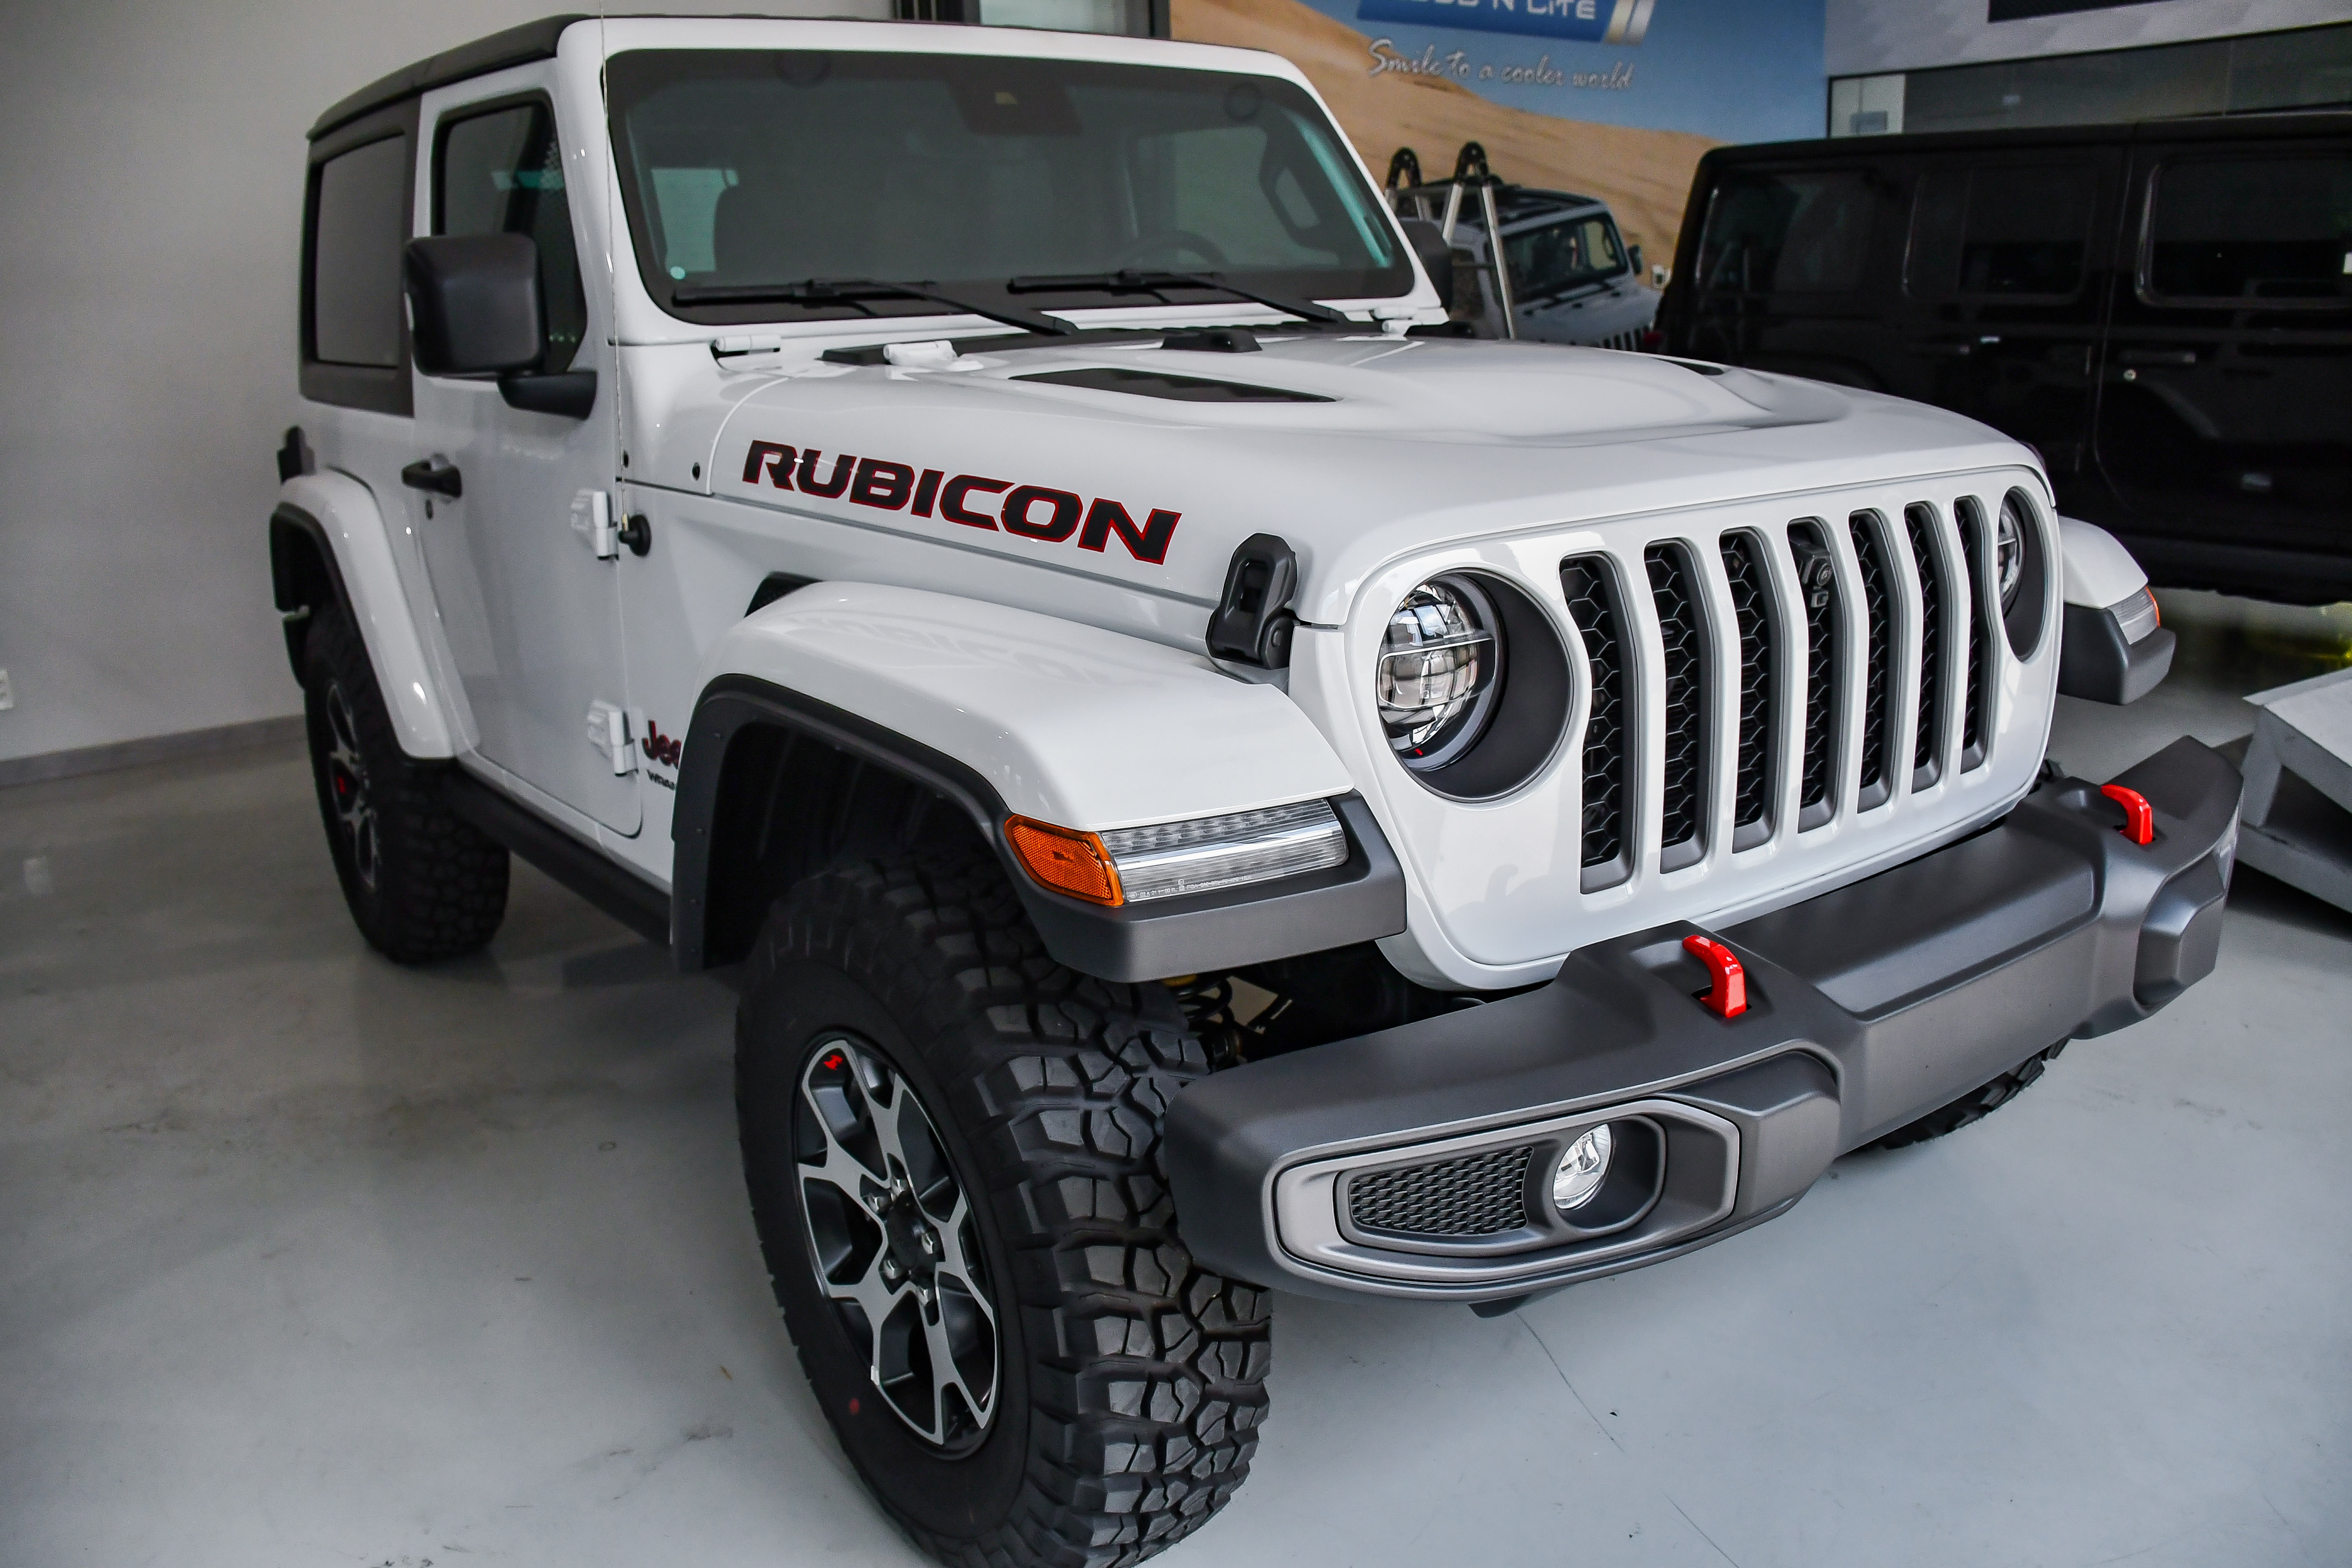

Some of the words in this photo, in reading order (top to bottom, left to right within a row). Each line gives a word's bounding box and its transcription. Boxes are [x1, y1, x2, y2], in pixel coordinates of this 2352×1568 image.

[1527, 0, 1596, 20] LITE
[1368, 38, 1441, 76] Smile
[1446, 51, 1471, 77] to
[1479, 65, 1494, 79] a
[1501, 55, 1563, 86] cooler
[1573, 62, 1634, 90] world
[742, 440, 1181, 565] RUBICON
[642, 719, 681, 769] Jee
